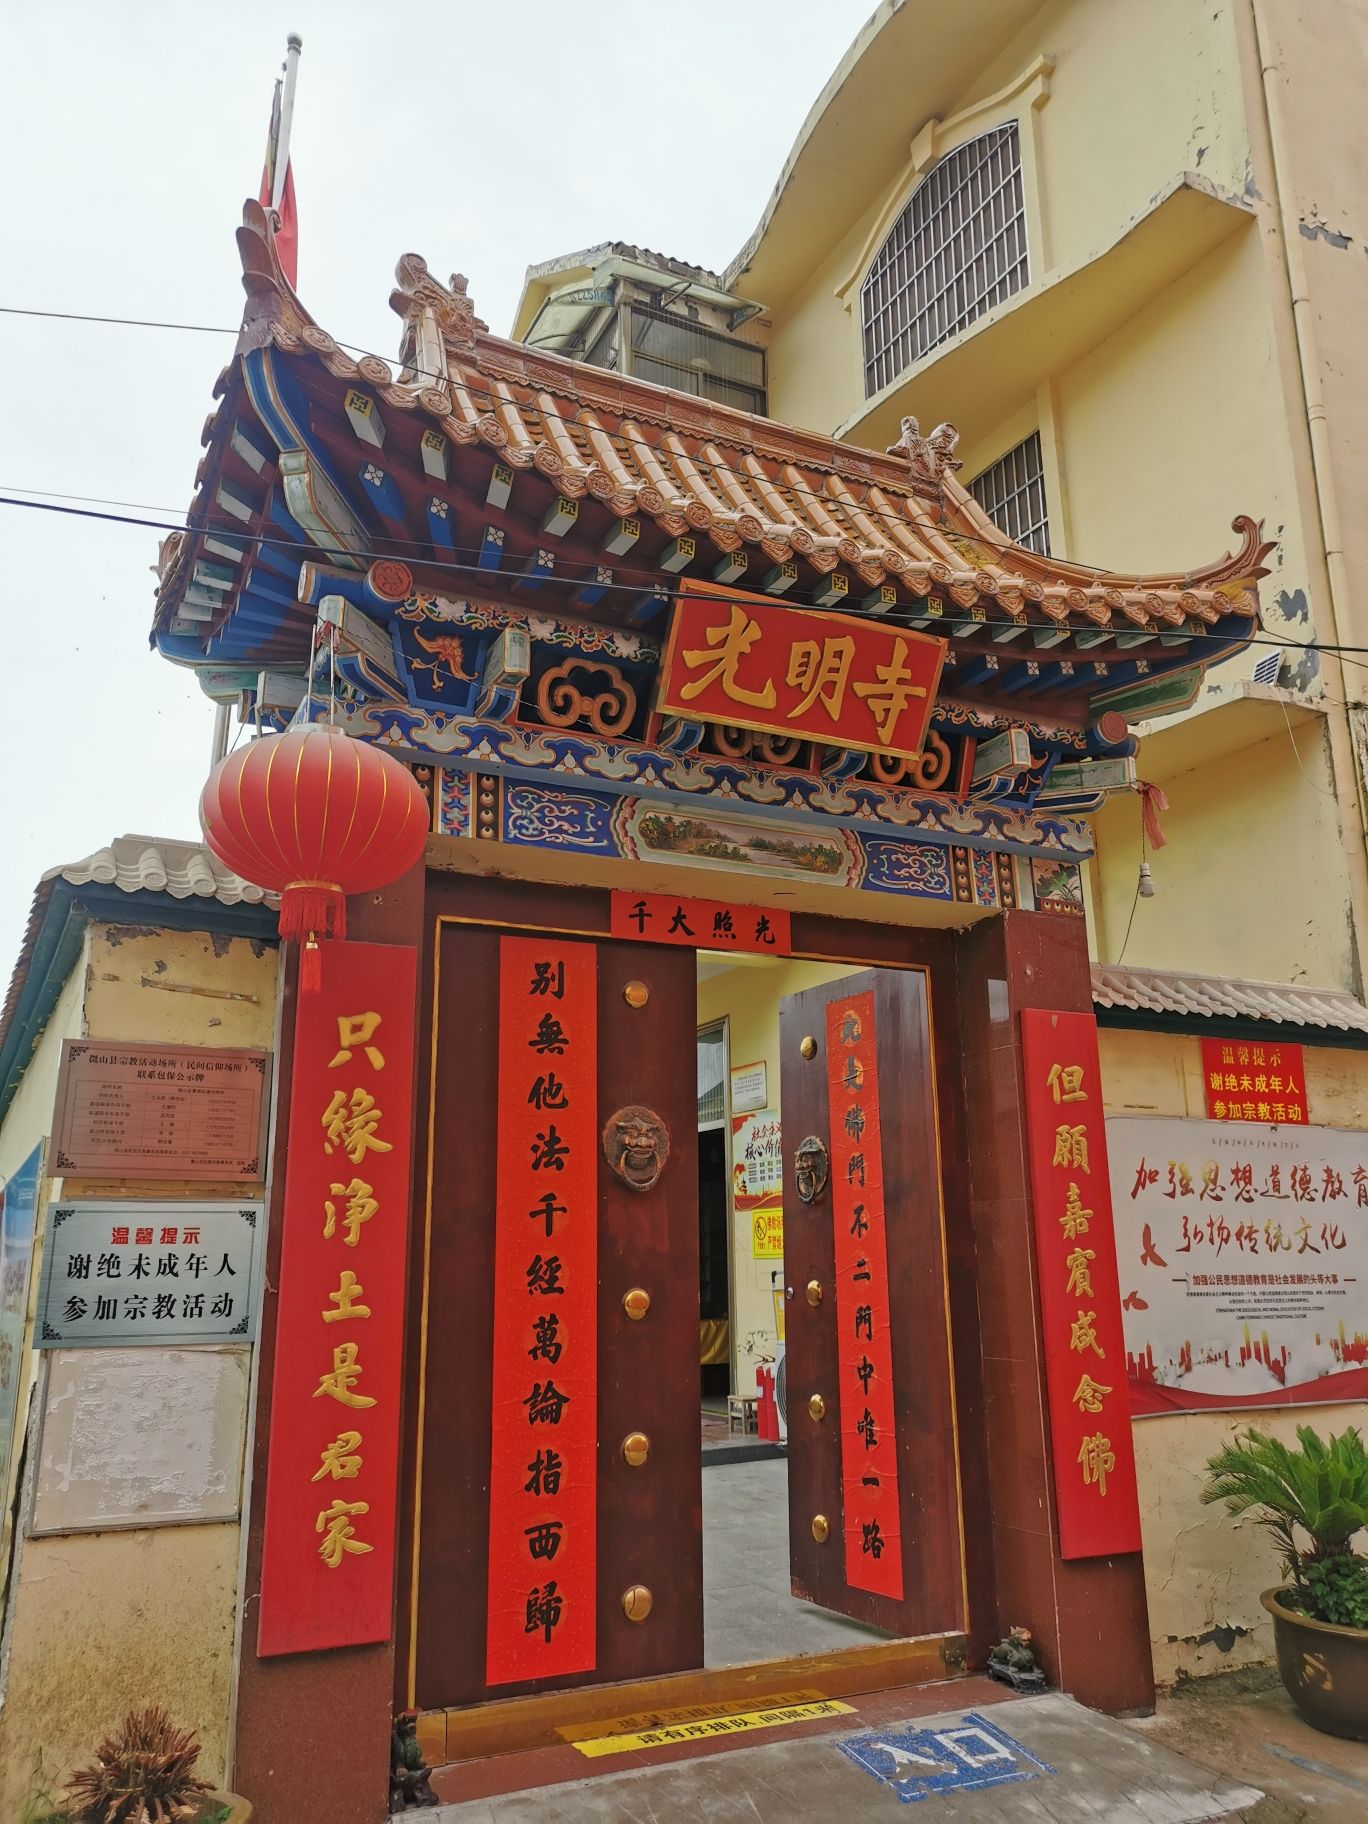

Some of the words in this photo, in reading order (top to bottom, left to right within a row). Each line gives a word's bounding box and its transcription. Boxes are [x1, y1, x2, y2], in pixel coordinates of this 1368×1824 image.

[680, 604, 927, 745] 光明寺
[1222, 1046, 1281, 1067] 温馨提示
[1210, 1072, 1299, 1094] 谢绝未成年人
[1213, 1099, 1302, 1120] 参加宗教活动
[111, 1227, 200, 1245] 温馨提示
[1176, 1214, 1347, 1258] 弘扬传统文化
[66, 1253, 237, 1279] 谢绝未成年人
[62, 1292, 234, 1323] 参加宗教活动
